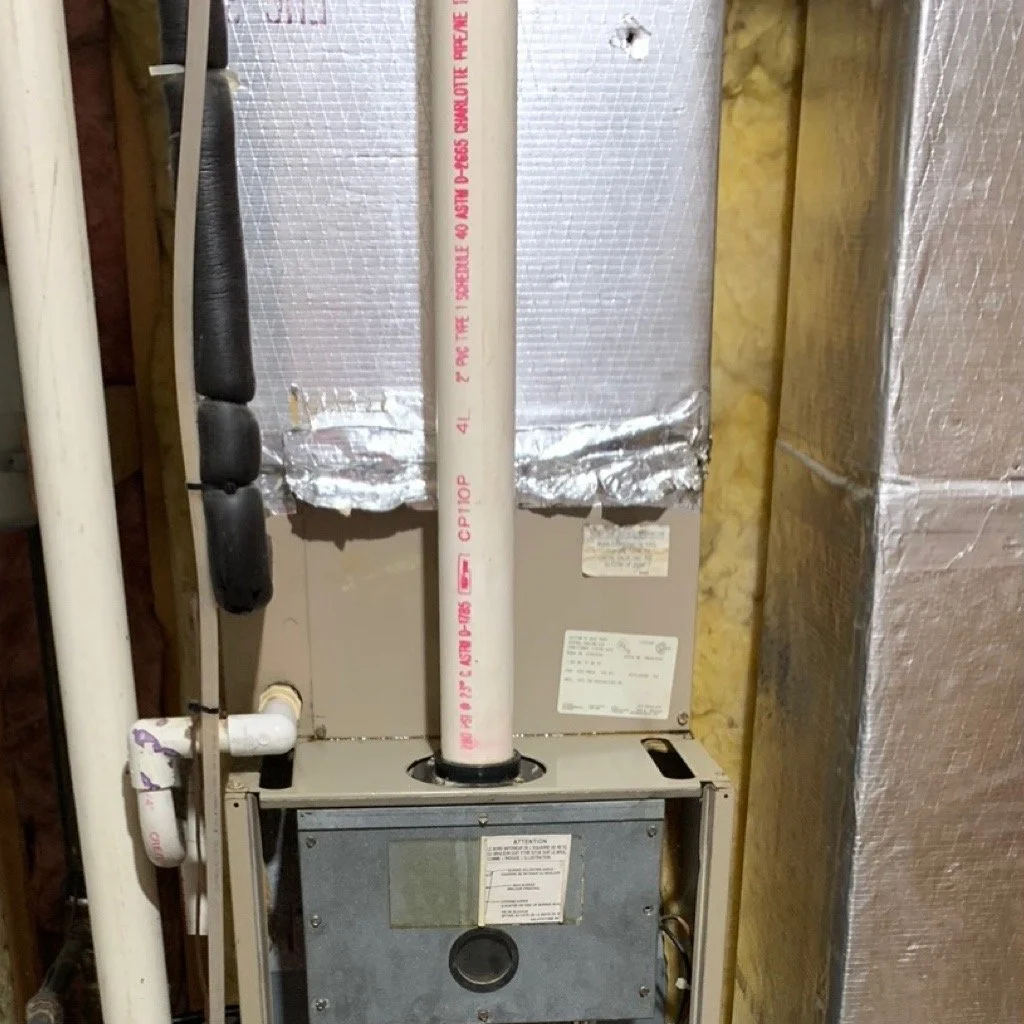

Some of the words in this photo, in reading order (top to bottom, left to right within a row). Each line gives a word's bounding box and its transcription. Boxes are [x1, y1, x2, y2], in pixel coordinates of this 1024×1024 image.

[453, 65, 469, 135] CHARLOTTE
[453, 188, 469, 221] ASTM
[454, 245, 469, 302] SCHEDULE
